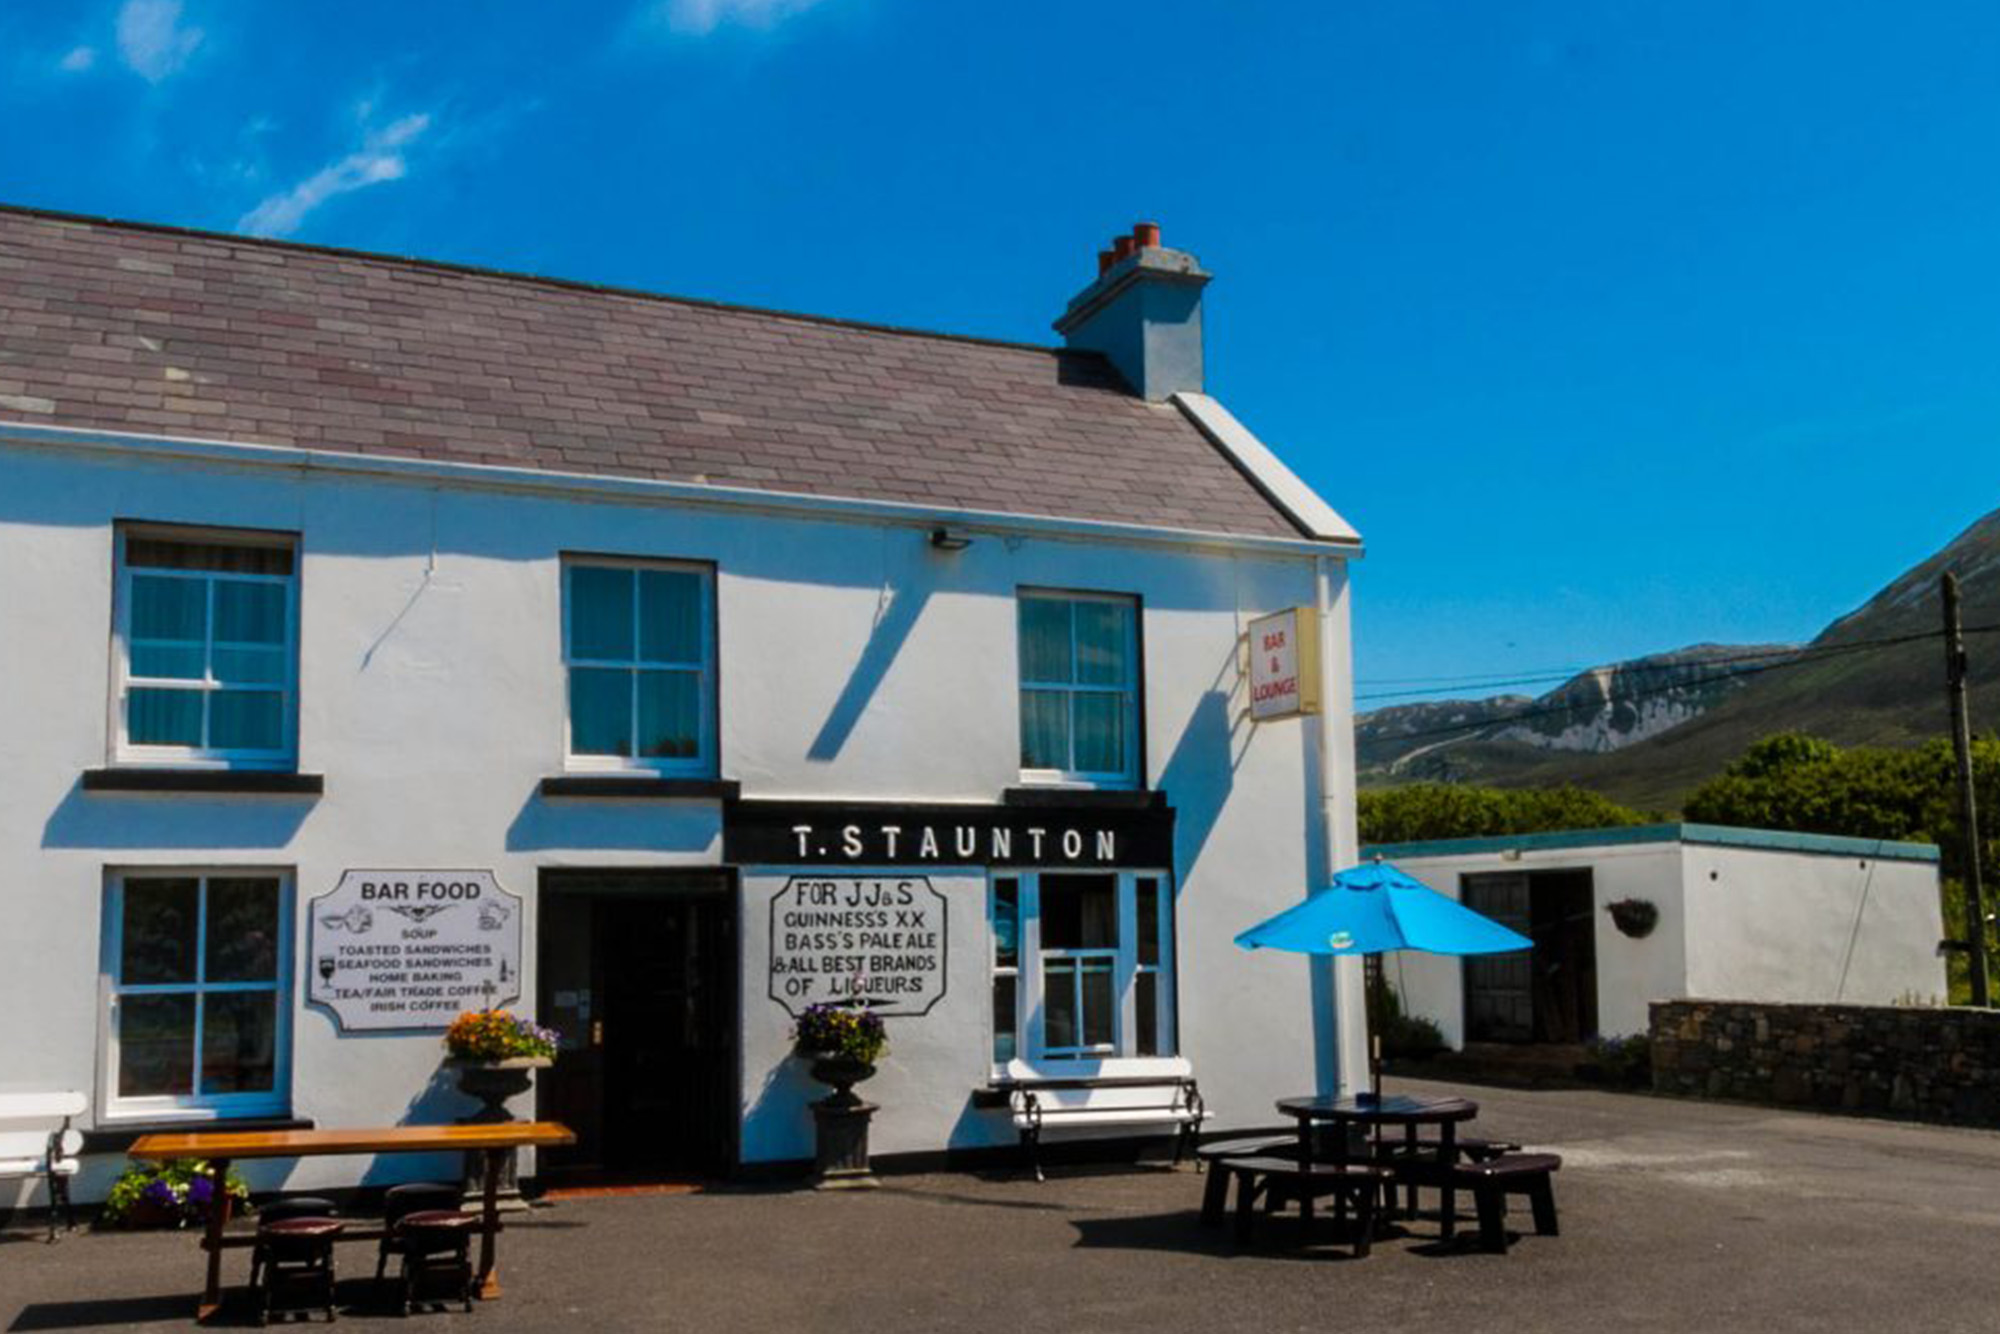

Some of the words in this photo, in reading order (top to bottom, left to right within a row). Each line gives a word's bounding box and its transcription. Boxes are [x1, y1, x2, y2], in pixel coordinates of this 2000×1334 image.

[1264, 631, 1285, 652] BAR
[1254, 677, 1297, 702] LOUNGE
[361, 882, 409, 900] BAR
[417, 882, 481, 900] FOOD
[796, 882, 837, 906] FOR
[401, 929, 437, 940] SOUP
[785, 931, 853, 950] BASS'S
[860, 933, 903, 949] PALE
[906, 933, 936, 949] ALE
[338, 945, 401, 956] TOASTED
[404, 944, 492, 955] SANDWICHES
[337, 958, 400, 970] SEAFOOD
[405, 957, 493, 969] SANDWICHES
[822, 956, 866, 973] BEST
[870, 955, 937, 972] BRANDS
[369, 972, 408, 983] HOME
[412, 971, 463, 982] BAKING
[335, 987, 396, 999] TEA/FAIR
[401, 985, 444, 997] TRADE
[785, 978, 813, 996] OF
[370, 1002, 405, 1012] IRISH
[409, 1000, 460, 1012] COFFEE
